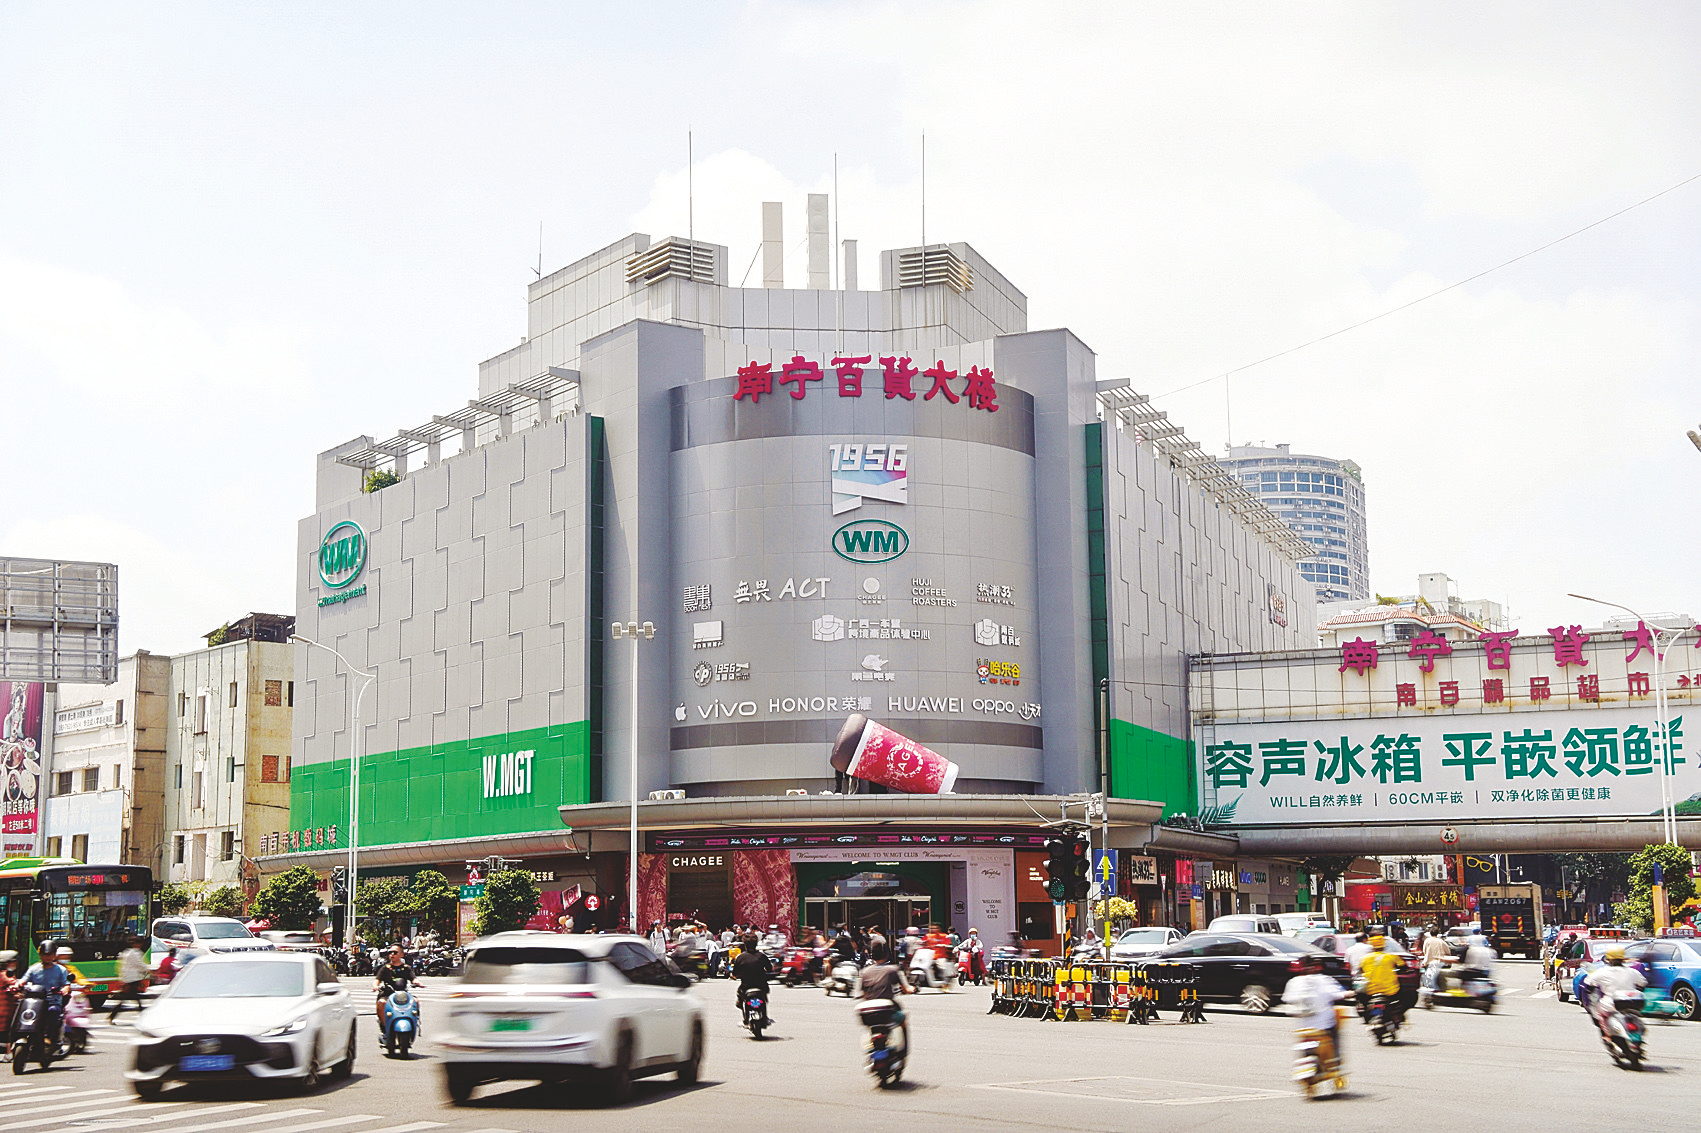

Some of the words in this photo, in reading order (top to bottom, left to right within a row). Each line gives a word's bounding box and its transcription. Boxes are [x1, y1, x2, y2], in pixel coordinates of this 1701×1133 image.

[733, 355, 999, 412] 南宁百貨大楼
[829, 443, 907, 471] 1956
[842, 531, 899, 554] WM
[323, 534, 360, 576] WM
[779, 577, 831, 600] ACT
[911, 578, 932, 587] HUJI
[911, 587, 946, 597] COFFEE
[911, 598, 957, 607] ROASTERS
[1338, 621, 1701, 677] 南宁百貨大
[714, 663, 736, 674] 1956
[989, 660, 1020, 678] 哈乐谷
[1396, 672, 1651, 707] 南百精品超市
[697, 699, 758, 719] vivo
[769, 697, 839, 713] HONOR
[841, 696, 872, 711] 荣耀
[888, 696, 964, 713] HUAWEI
[1205, 733, 1422, 789] 容声冰箱
[1442, 715, 1687, 782] 平嵌领鲜
[482, 749, 537, 799] W.MGT
[1491, 787, 1611, 802] 双净化除菌更健康
[673, 856, 723, 867] CHAGEE
[92, 874, 104, 885] 301
